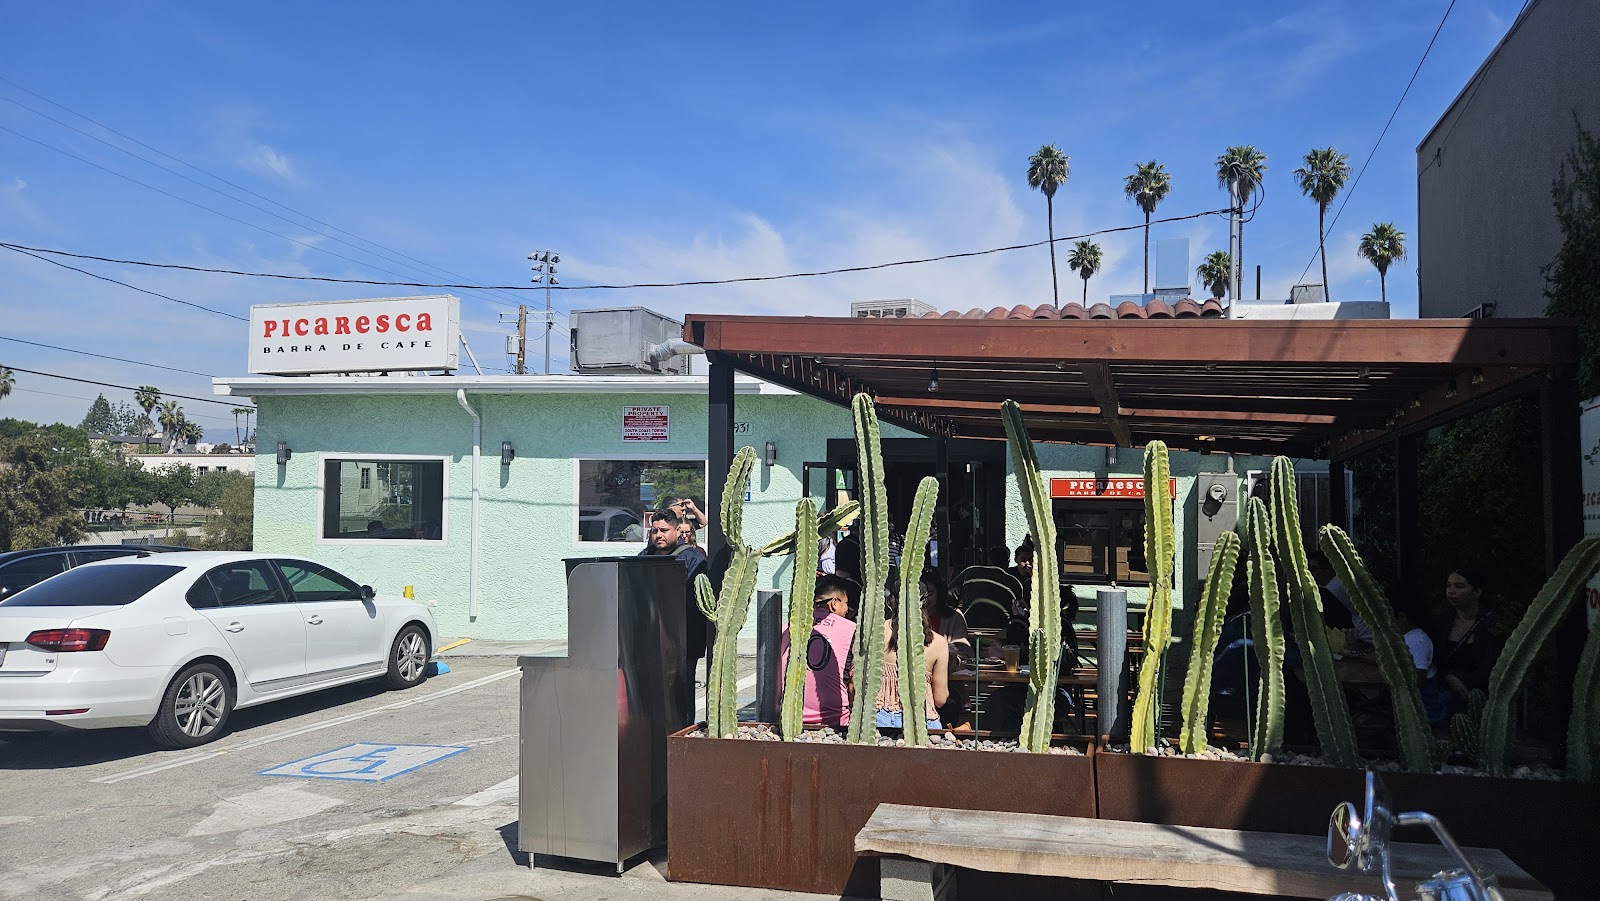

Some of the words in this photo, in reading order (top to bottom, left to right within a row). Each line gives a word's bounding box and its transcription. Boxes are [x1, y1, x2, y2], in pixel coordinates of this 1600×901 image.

[263, 344, 327, 354] BARRA
[342, 343, 364, 351] DE
[381, 340, 432, 349] CAFE
[1069, 481, 1144, 490] PIcaResc
